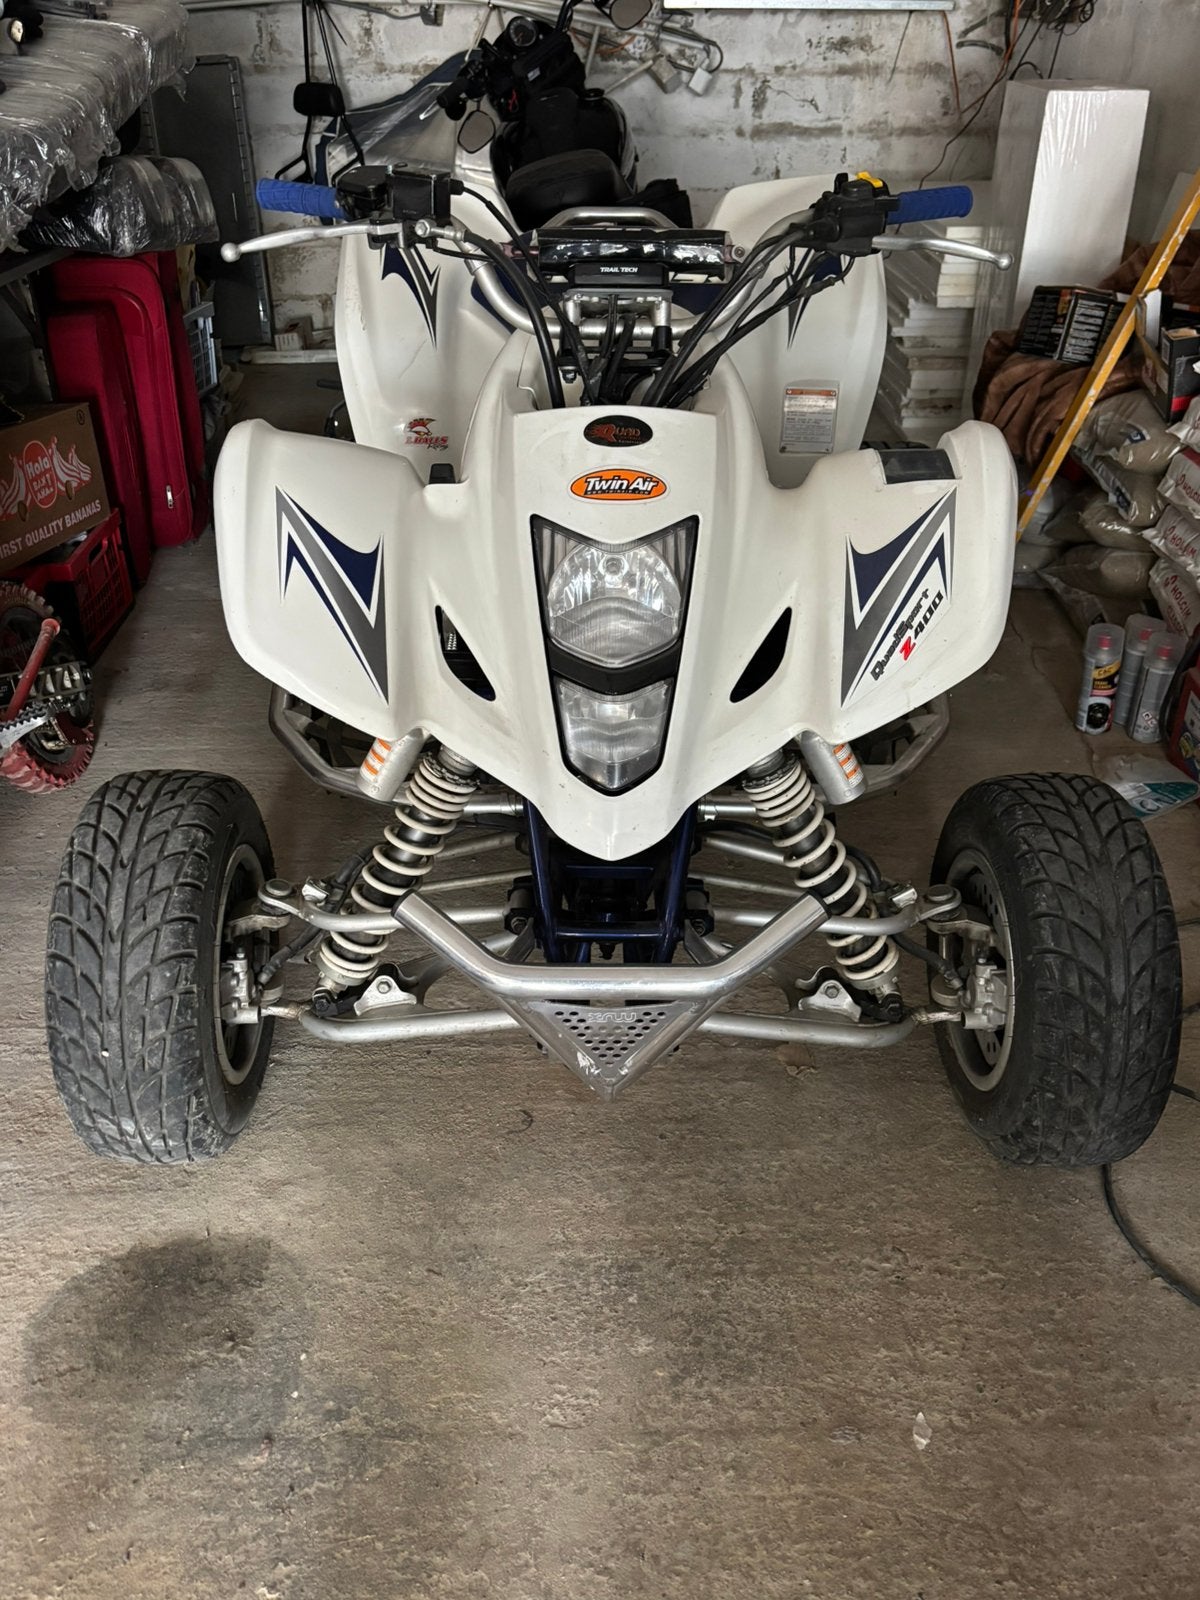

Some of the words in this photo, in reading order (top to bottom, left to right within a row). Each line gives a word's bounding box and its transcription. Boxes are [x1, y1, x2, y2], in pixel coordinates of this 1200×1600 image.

[26, 456, 51, 480] Hola
[586, 476, 629, 491] Twin
[629, 476, 658, 491] Air
[0, 537, 23, 560] IRST
[25, 516, 64, 547] QUALITY
[65, 500, 102, 528] BANANAS
[899, 636, 916, 661] Z
[914, 590, 944, 640] 400
[1171, 585, 1192, 619] HOLCIM
[870, 588, 929, 681] QuadSport
